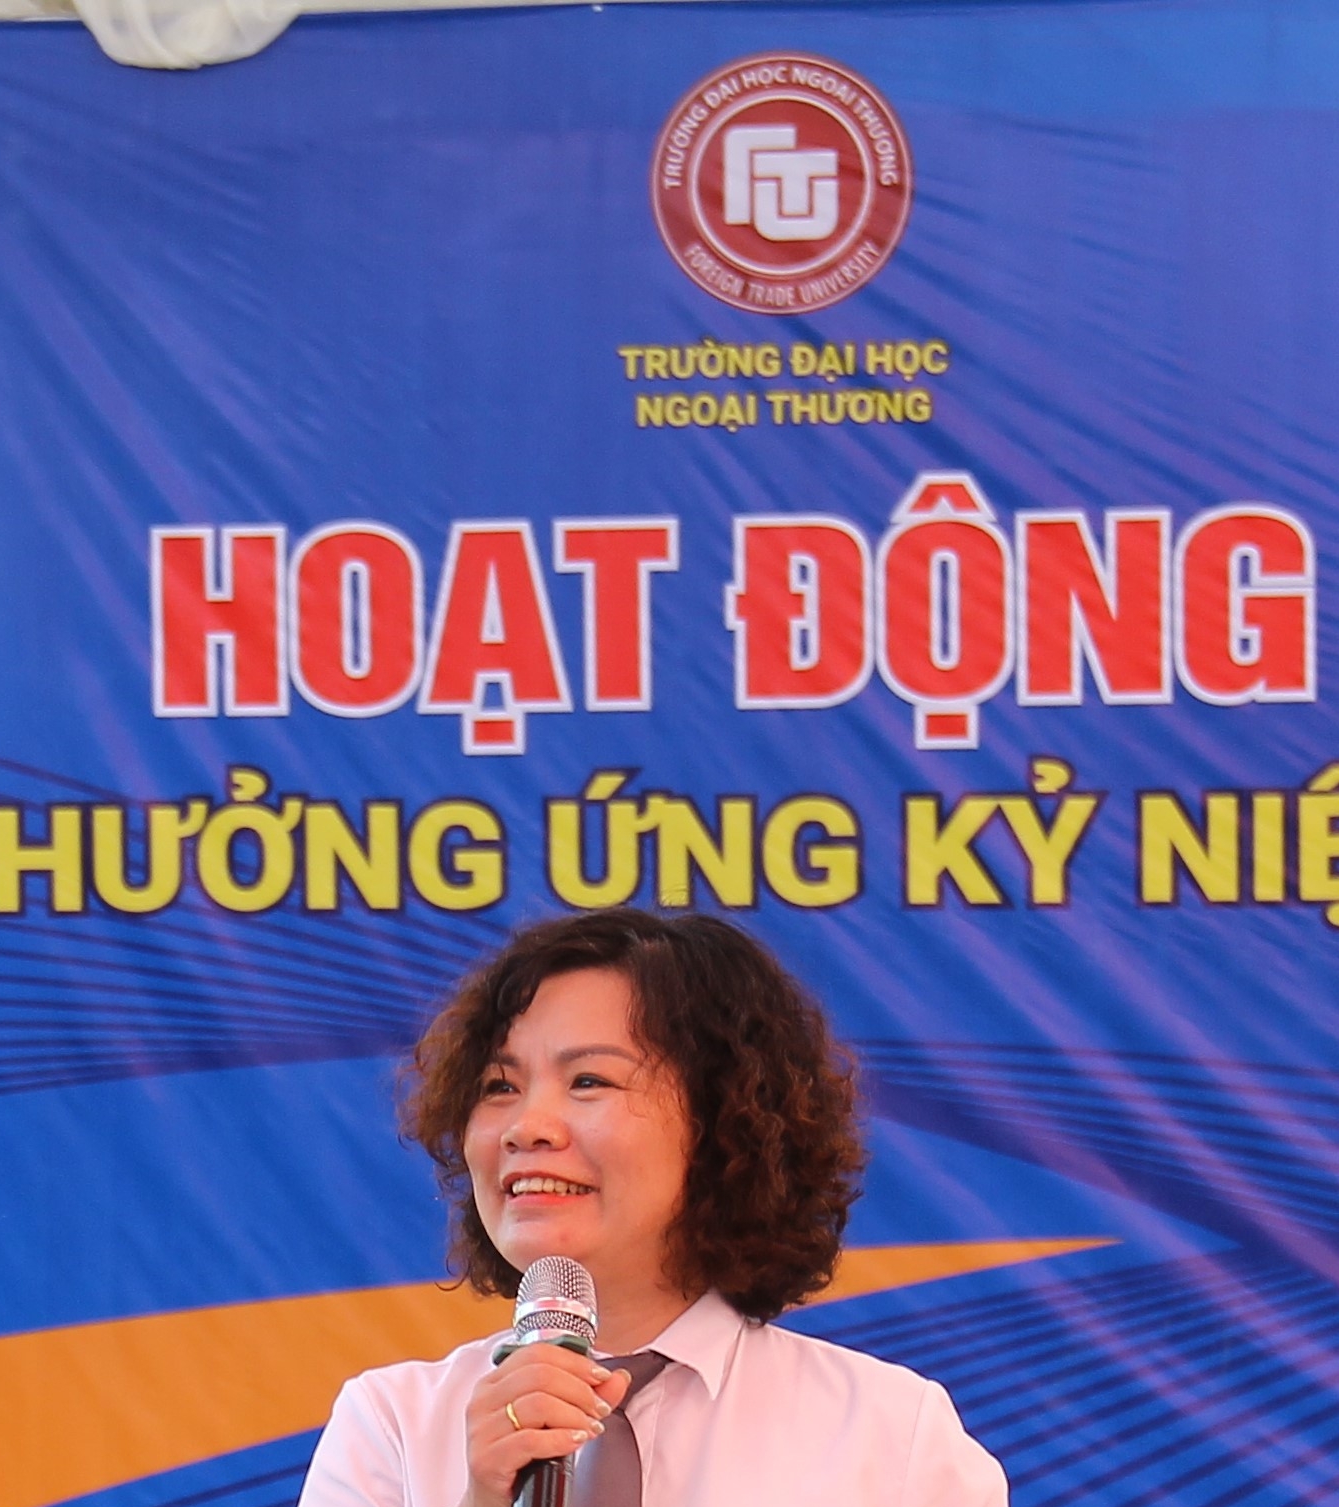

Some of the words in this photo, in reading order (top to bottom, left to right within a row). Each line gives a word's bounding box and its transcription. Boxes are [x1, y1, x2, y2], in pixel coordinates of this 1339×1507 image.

[684, 243, 744, 298] FOREIGN
[747, 284, 796, 306] TRADE
[799, 240, 881, 304] UNIVERSITY
[617, 335, 782, 381] TRƯỜNG
[789, 342, 856, 382] ĐẠI
[864, 342, 950, 382] HỌC
[635, 393, 758, 433] NGOẠI
[765, 388, 934, 426] THƯƠNG
[149, 516, 680, 756] HOẠT
[725, 471, 1319, 750] ĐỘNG
[546, 769, 861, 911] ỨNG
[901, 757, 1105, 911] KỶ
